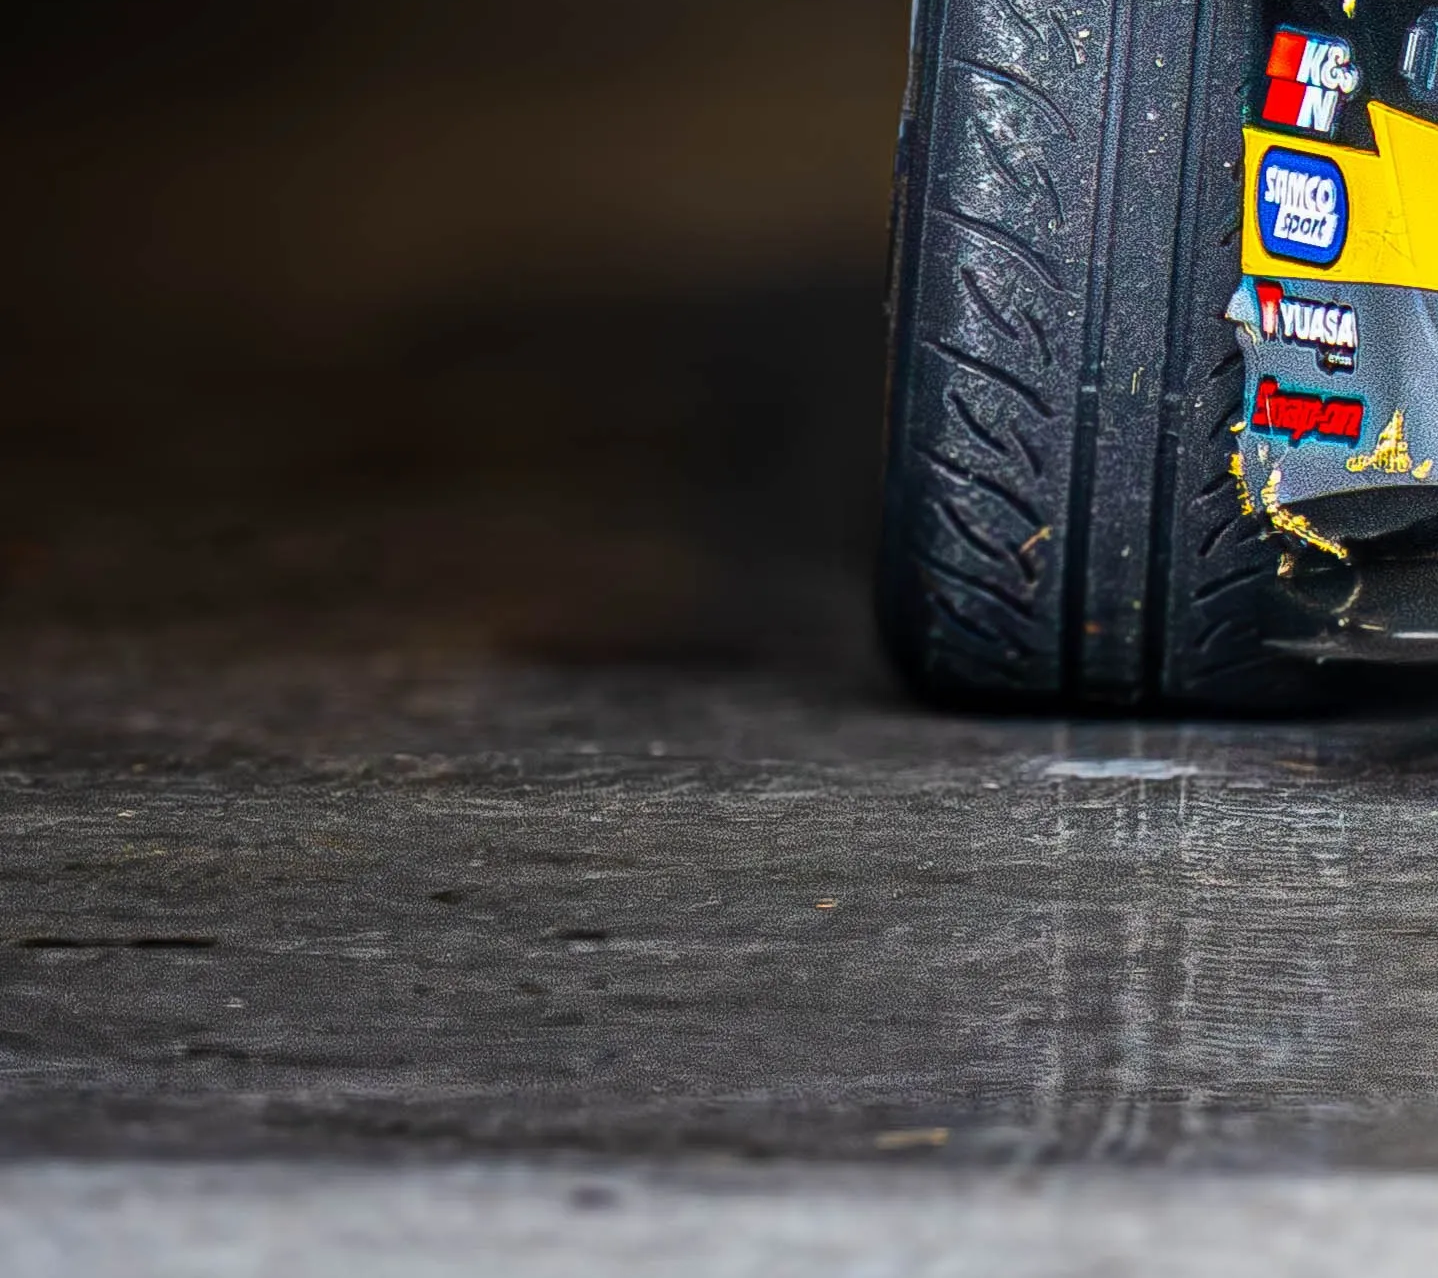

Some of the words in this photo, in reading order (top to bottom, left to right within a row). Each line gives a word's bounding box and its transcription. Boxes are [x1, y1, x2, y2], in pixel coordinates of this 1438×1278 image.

[1263, 163, 1339, 217] SAMCO
[1280, 211, 1328, 241] sport
[1279, 298, 1359, 348] YUASA
